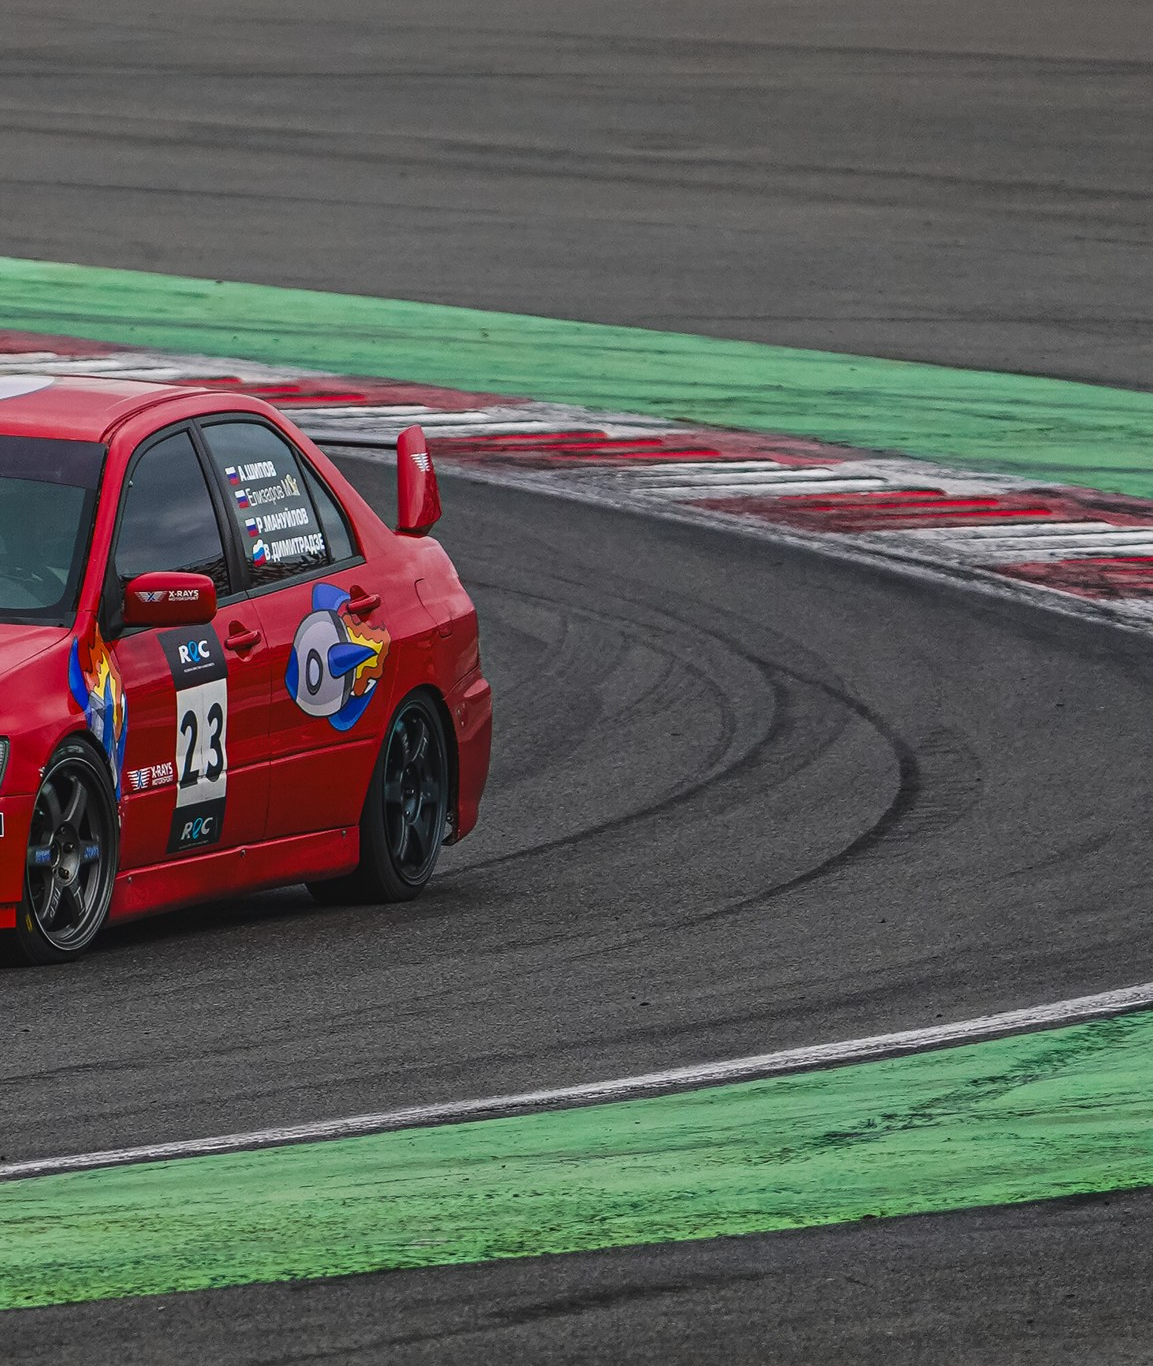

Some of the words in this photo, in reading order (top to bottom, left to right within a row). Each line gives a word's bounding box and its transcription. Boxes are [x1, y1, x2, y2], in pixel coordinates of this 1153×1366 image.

[168, 589, 199, 598] X-RAYS
[180, 702, 224, 790] 23
[150, 761, 174, 779] X-RAYS
